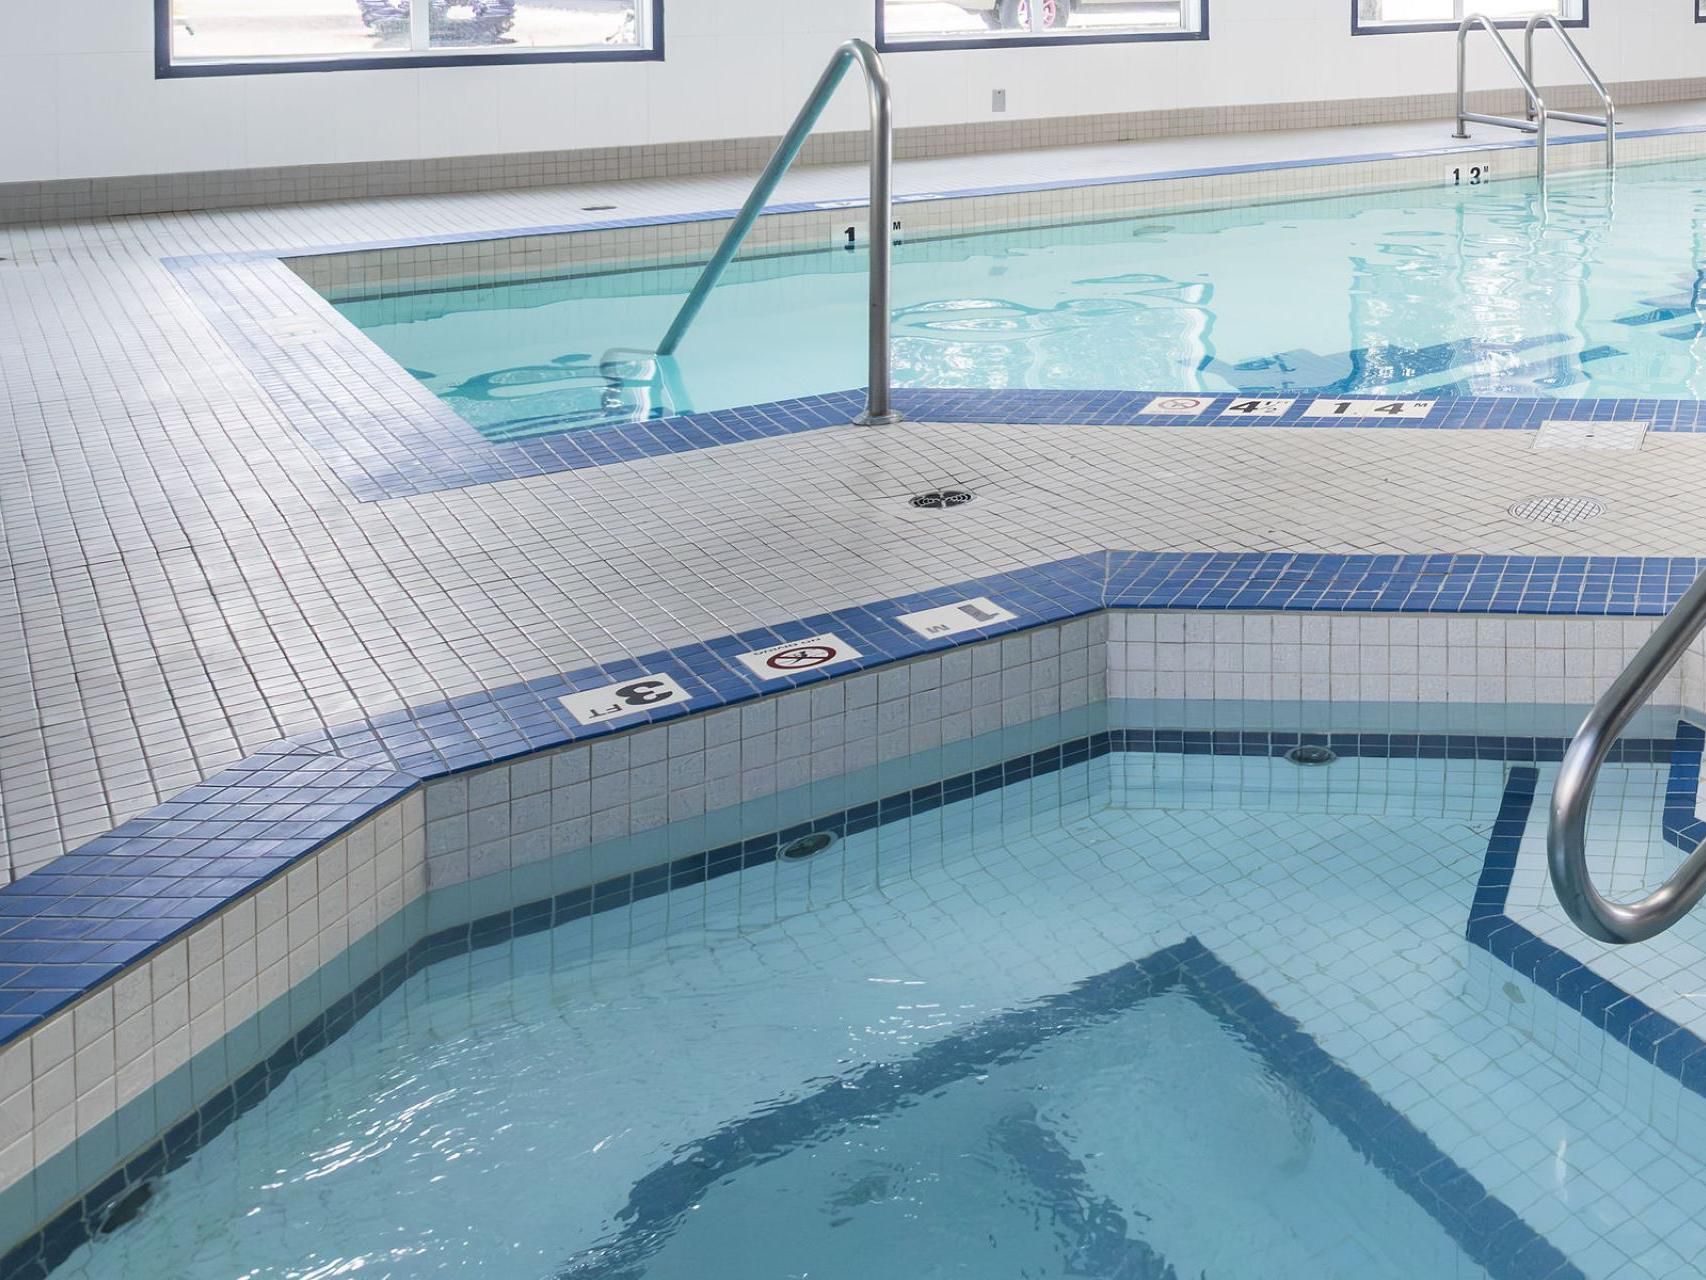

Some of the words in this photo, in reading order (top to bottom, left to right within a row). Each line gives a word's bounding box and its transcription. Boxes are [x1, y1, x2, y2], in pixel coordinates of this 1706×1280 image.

[957, 604, 1001, 623] 1
[925, 624, 951, 634] M
[615, 680, 674, 706] 3
[588, 703, 623, 720] FT
